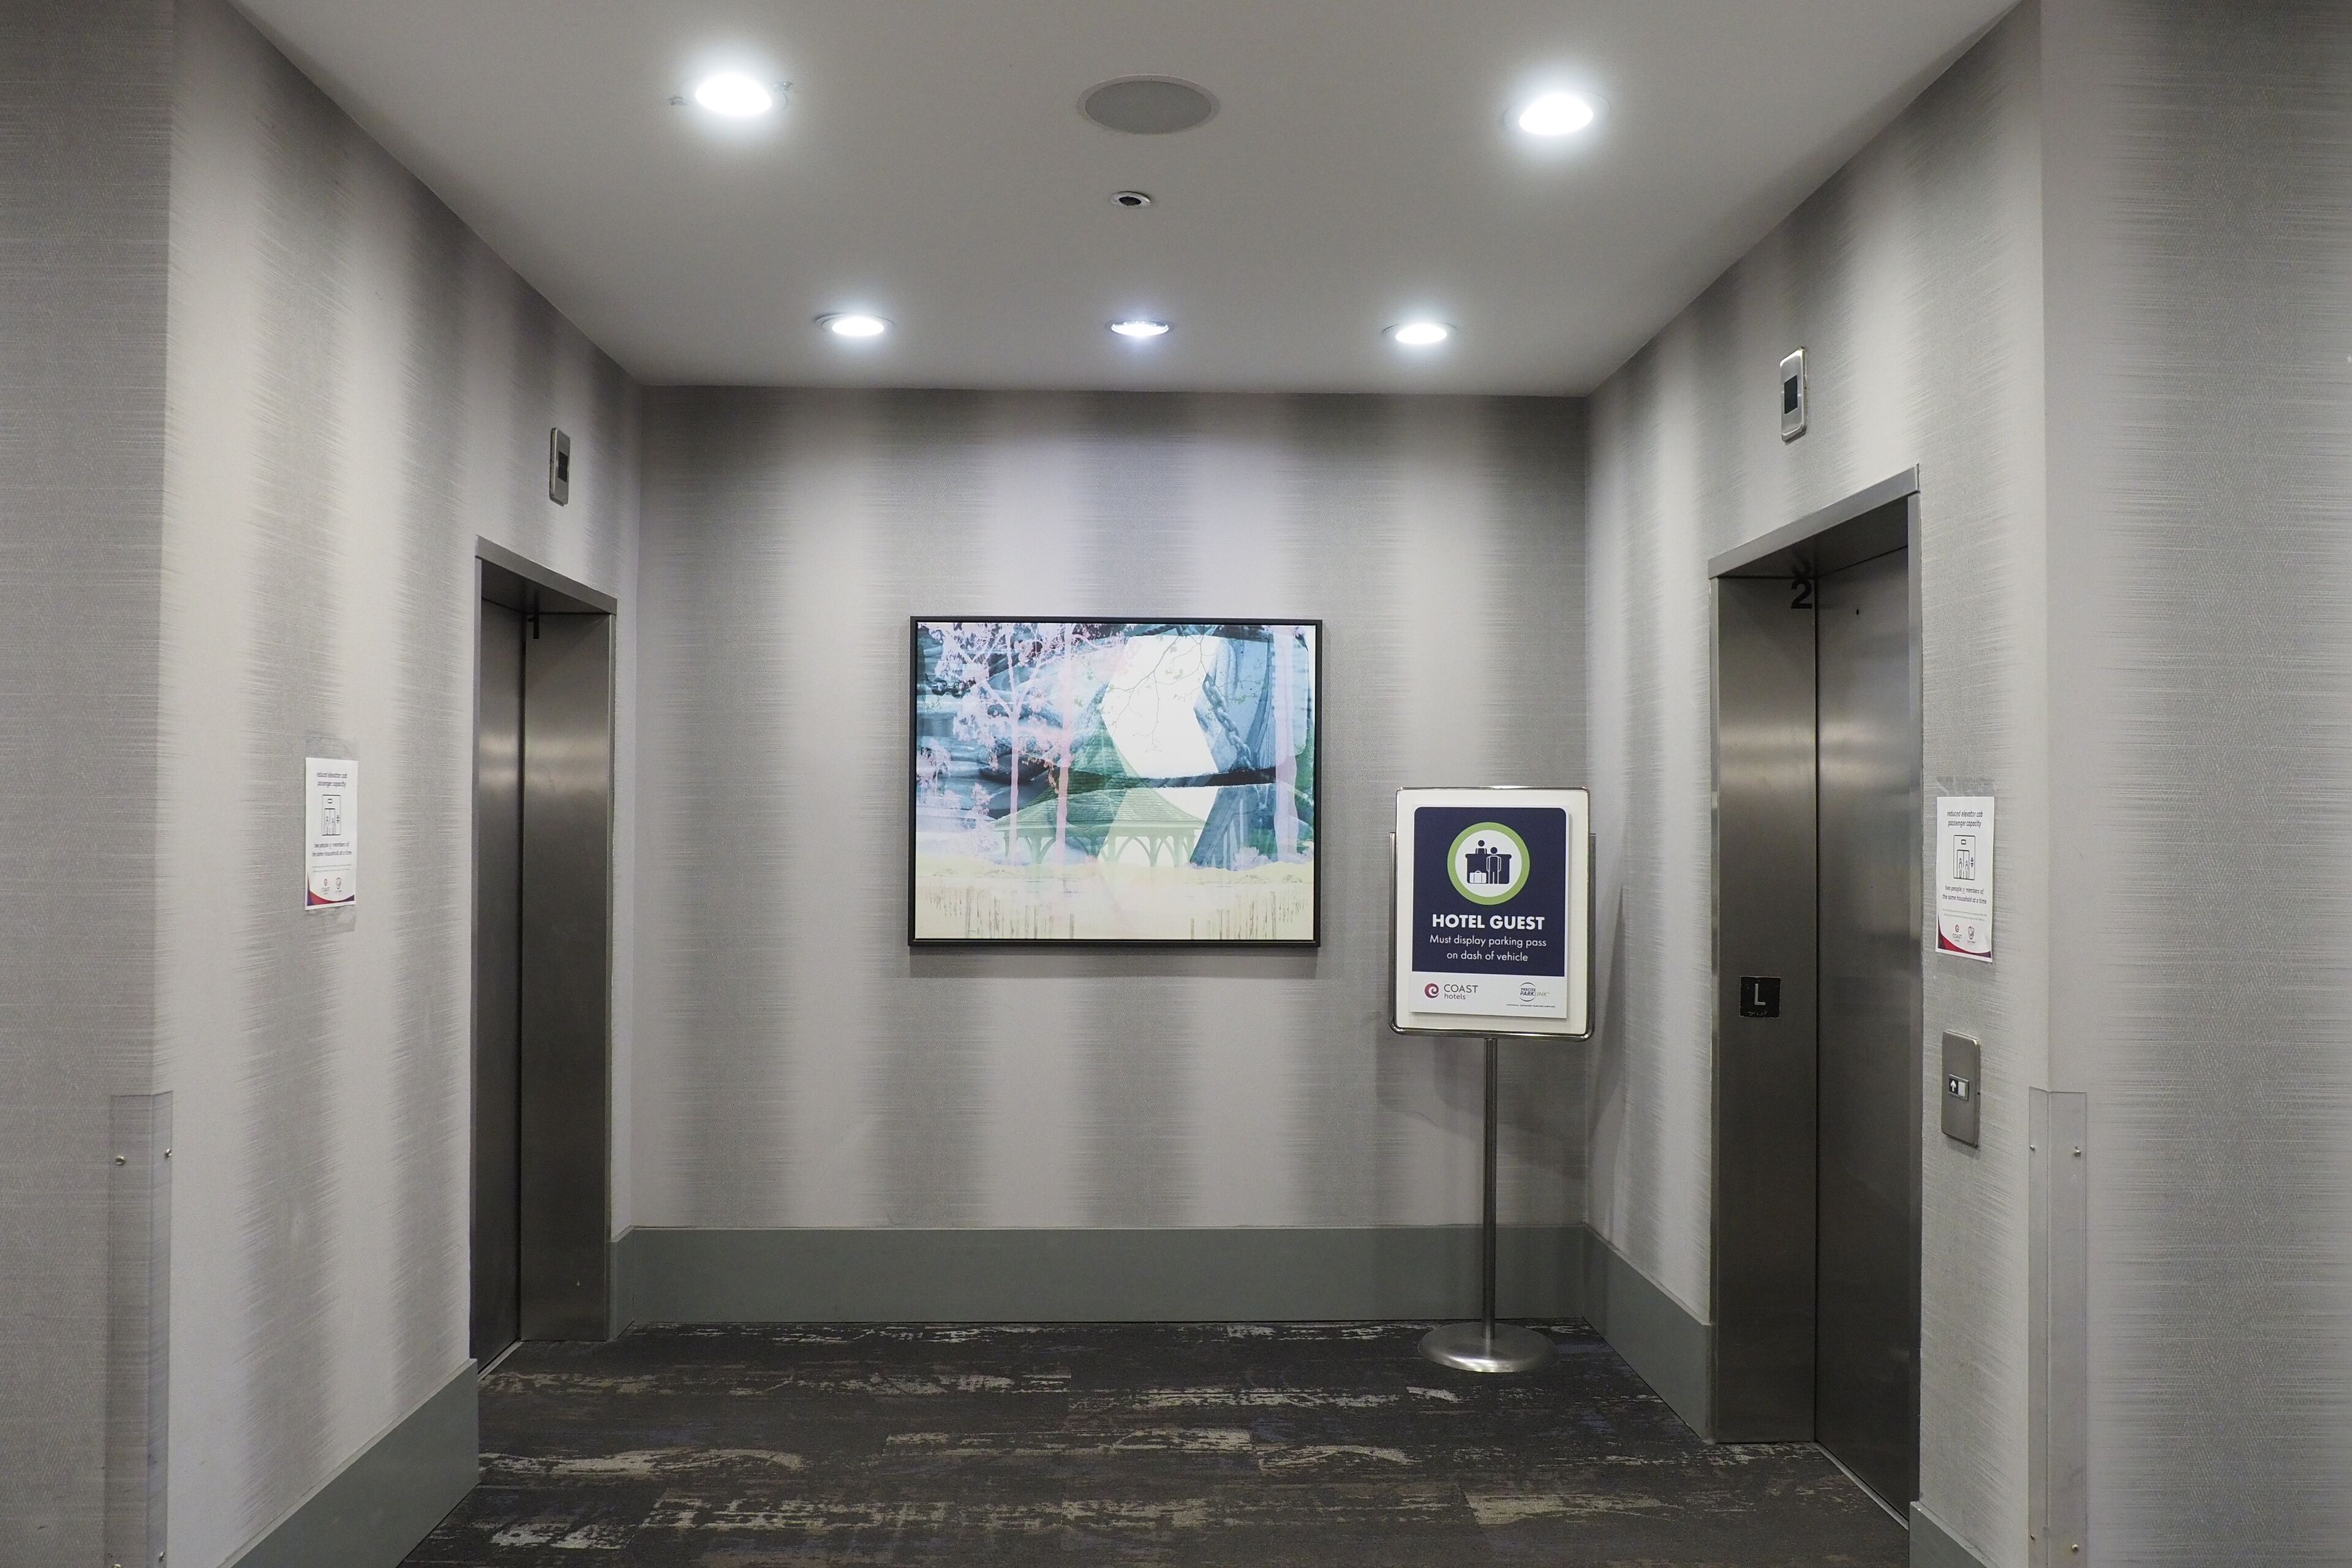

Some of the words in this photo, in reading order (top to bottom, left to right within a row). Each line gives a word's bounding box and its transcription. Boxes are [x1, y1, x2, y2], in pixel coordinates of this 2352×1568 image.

[1791, 578, 1812, 609] 2
[527, 612, 540, 639] 1
[1966, 820, 1981, 828] capacity
[1433, 914, 1485, 929] HOTEL
[1490, 915, 1545, 930] GUEST
[1430, 934, 1451, 944] Must
[1453, 934, 1486, 947] display
[1488, 935, 1523, 948] parking
[1526, 940, 1547, 949] pass
[1461, 950, 1482, 960] dash
[1485, 951, 1494, 960] of
[1496, 951, 1528, 961] vehicle
[1444, 984, 1479, 993] COAST
[1754, 983, 1766, 1005] L
